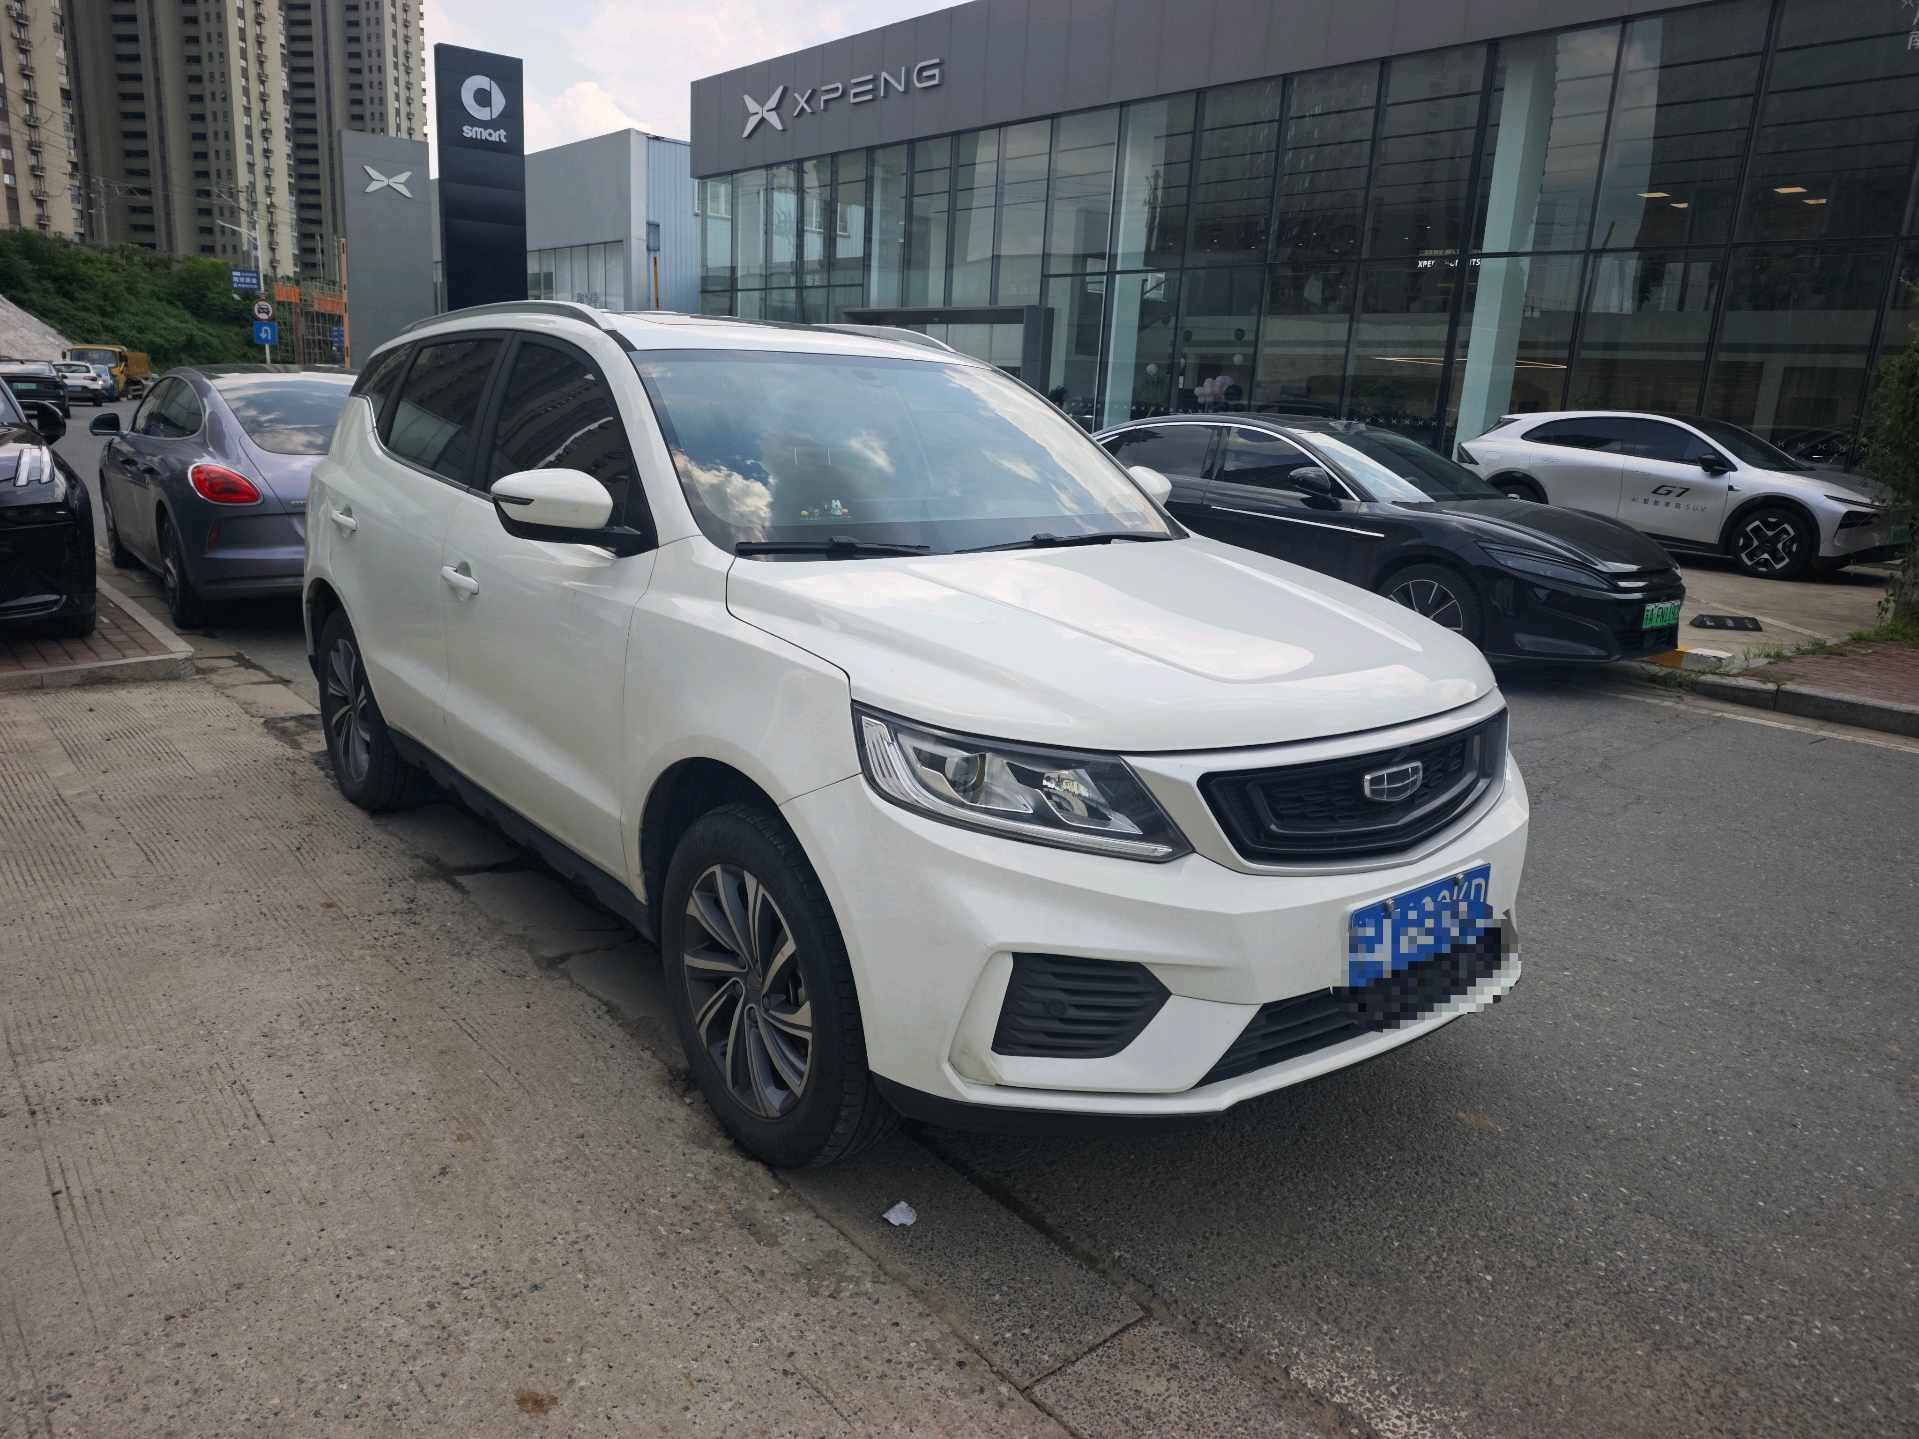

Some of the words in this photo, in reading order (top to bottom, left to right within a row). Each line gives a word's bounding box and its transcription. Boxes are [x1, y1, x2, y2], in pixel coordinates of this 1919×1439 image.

[793, 57, 942, 117] XPENG
[462, 125, 507, 143] smart
[1651, 485, 1691, 498] G7
